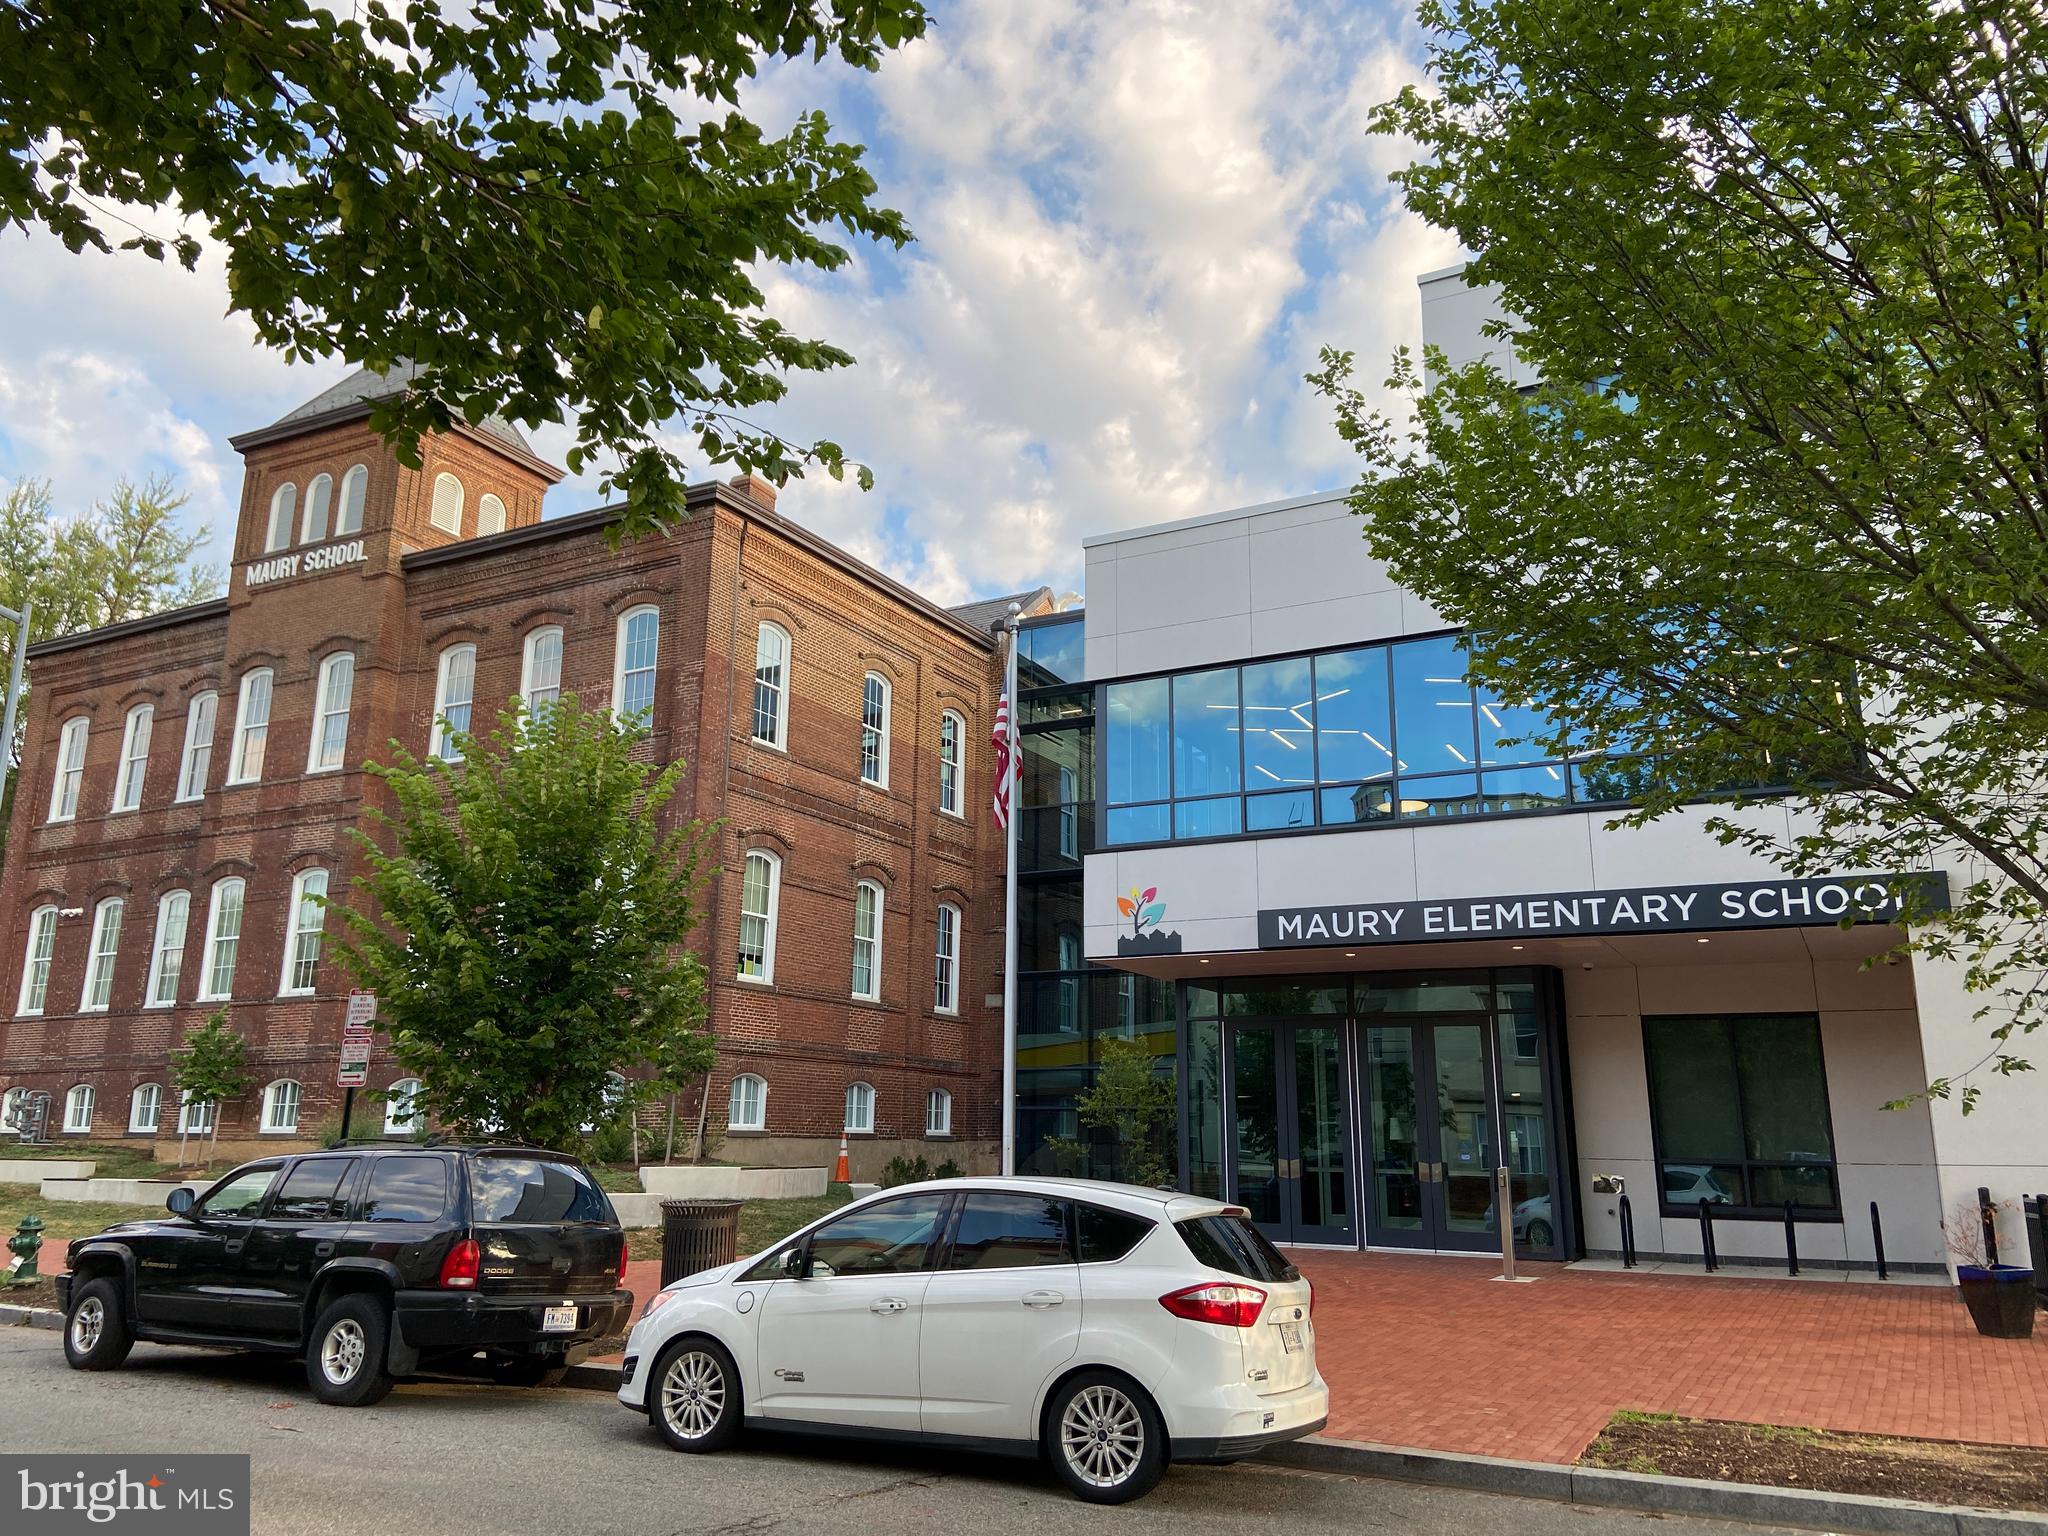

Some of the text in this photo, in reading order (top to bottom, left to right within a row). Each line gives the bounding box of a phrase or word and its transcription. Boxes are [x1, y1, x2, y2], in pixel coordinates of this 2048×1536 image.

[246, 540, 368, 586] MAURY SCHOOL
[1278, 909, 1404, 940] MAURY
[1423, 892, 1698, 933] ELEMENTARY
